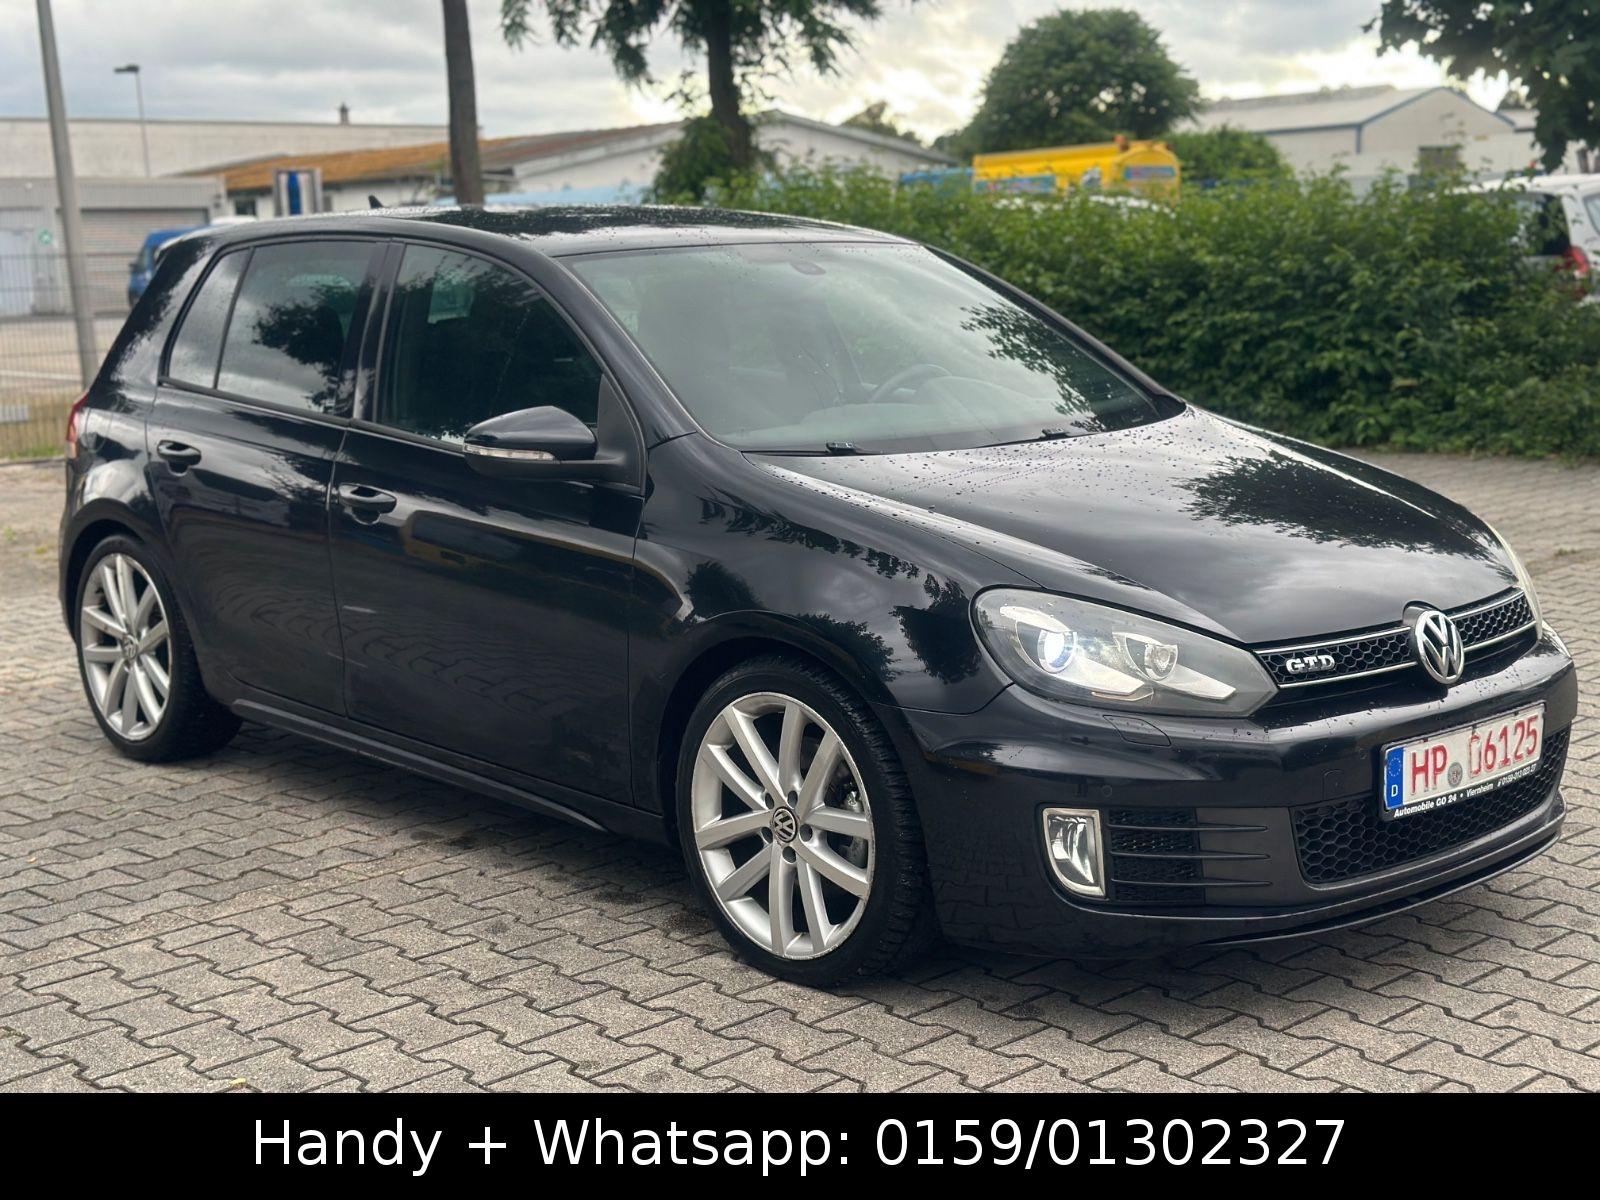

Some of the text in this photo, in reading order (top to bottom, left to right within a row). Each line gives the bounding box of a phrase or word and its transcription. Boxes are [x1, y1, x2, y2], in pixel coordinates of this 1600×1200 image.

[1285, 653, 1336, 675] GTD
[1410, 744, 1448, 794] HP
[1391, 784, 1399, 798] D
[1393, 800, 1435, 819] Automobile
